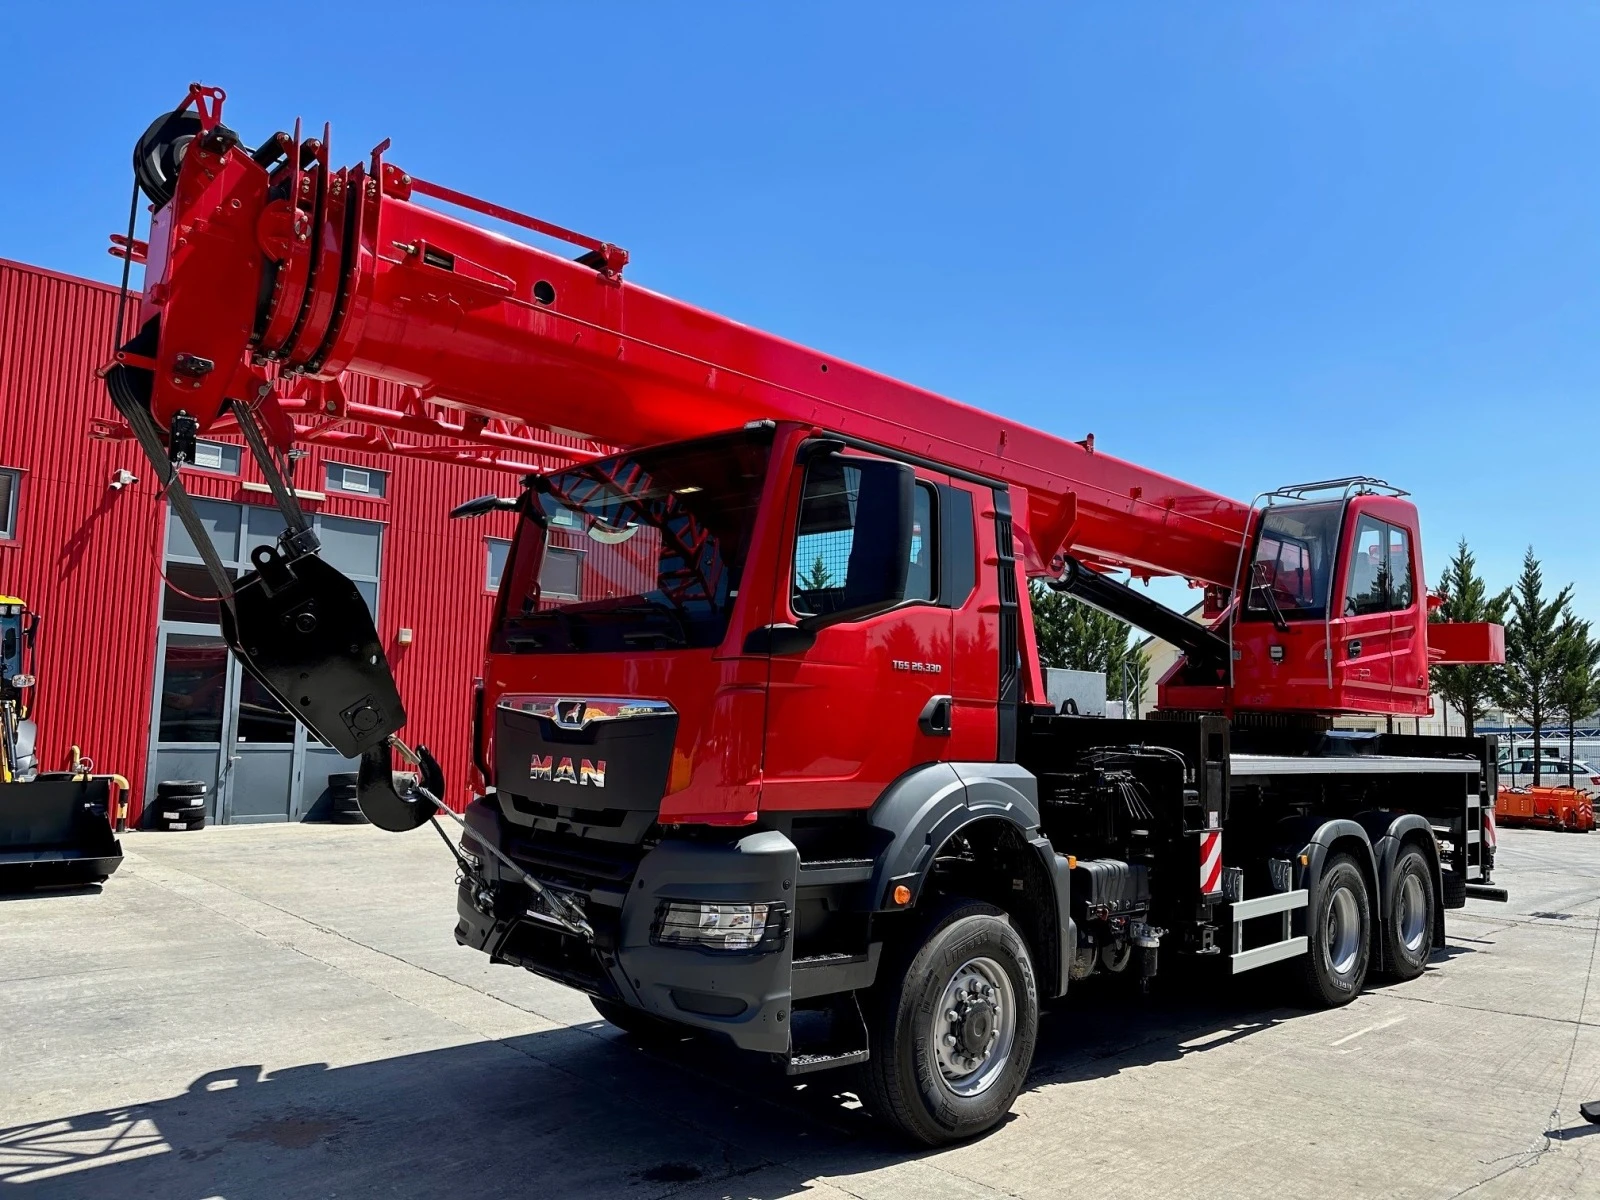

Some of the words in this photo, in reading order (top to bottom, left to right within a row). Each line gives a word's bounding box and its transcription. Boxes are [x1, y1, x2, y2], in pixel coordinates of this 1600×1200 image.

[892, 660, 910, 670] TGS
[911, 662, 942, 673] 26.330
[530, 754, 607, 788] MAN
